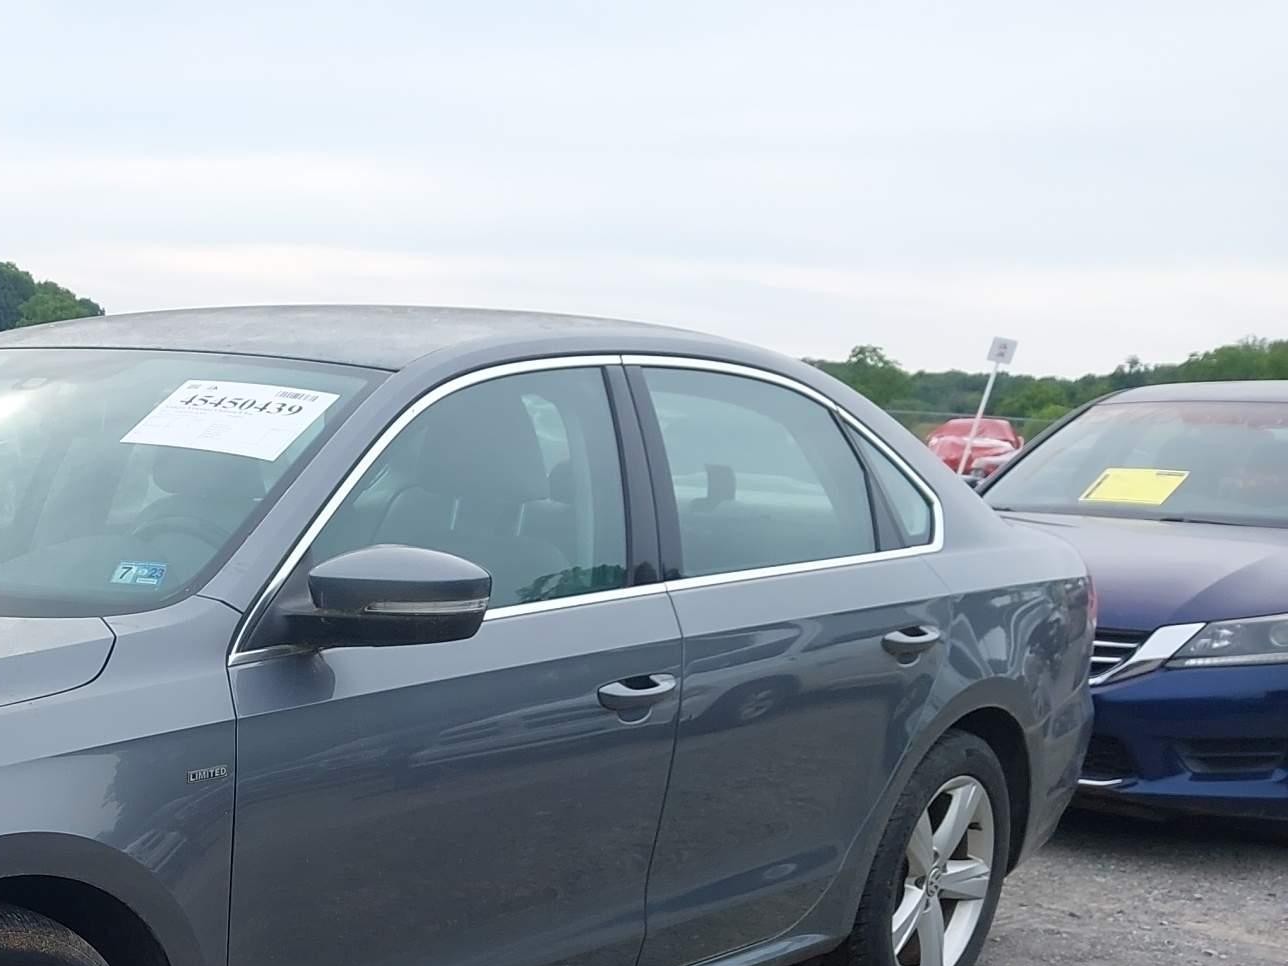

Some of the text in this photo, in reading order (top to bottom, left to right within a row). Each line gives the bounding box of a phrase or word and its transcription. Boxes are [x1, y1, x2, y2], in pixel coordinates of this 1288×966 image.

[179, 393, 304, 417] 45450439
[119, 566, 133, 580] 7
[190, 767, 226, 781] LIMITED
